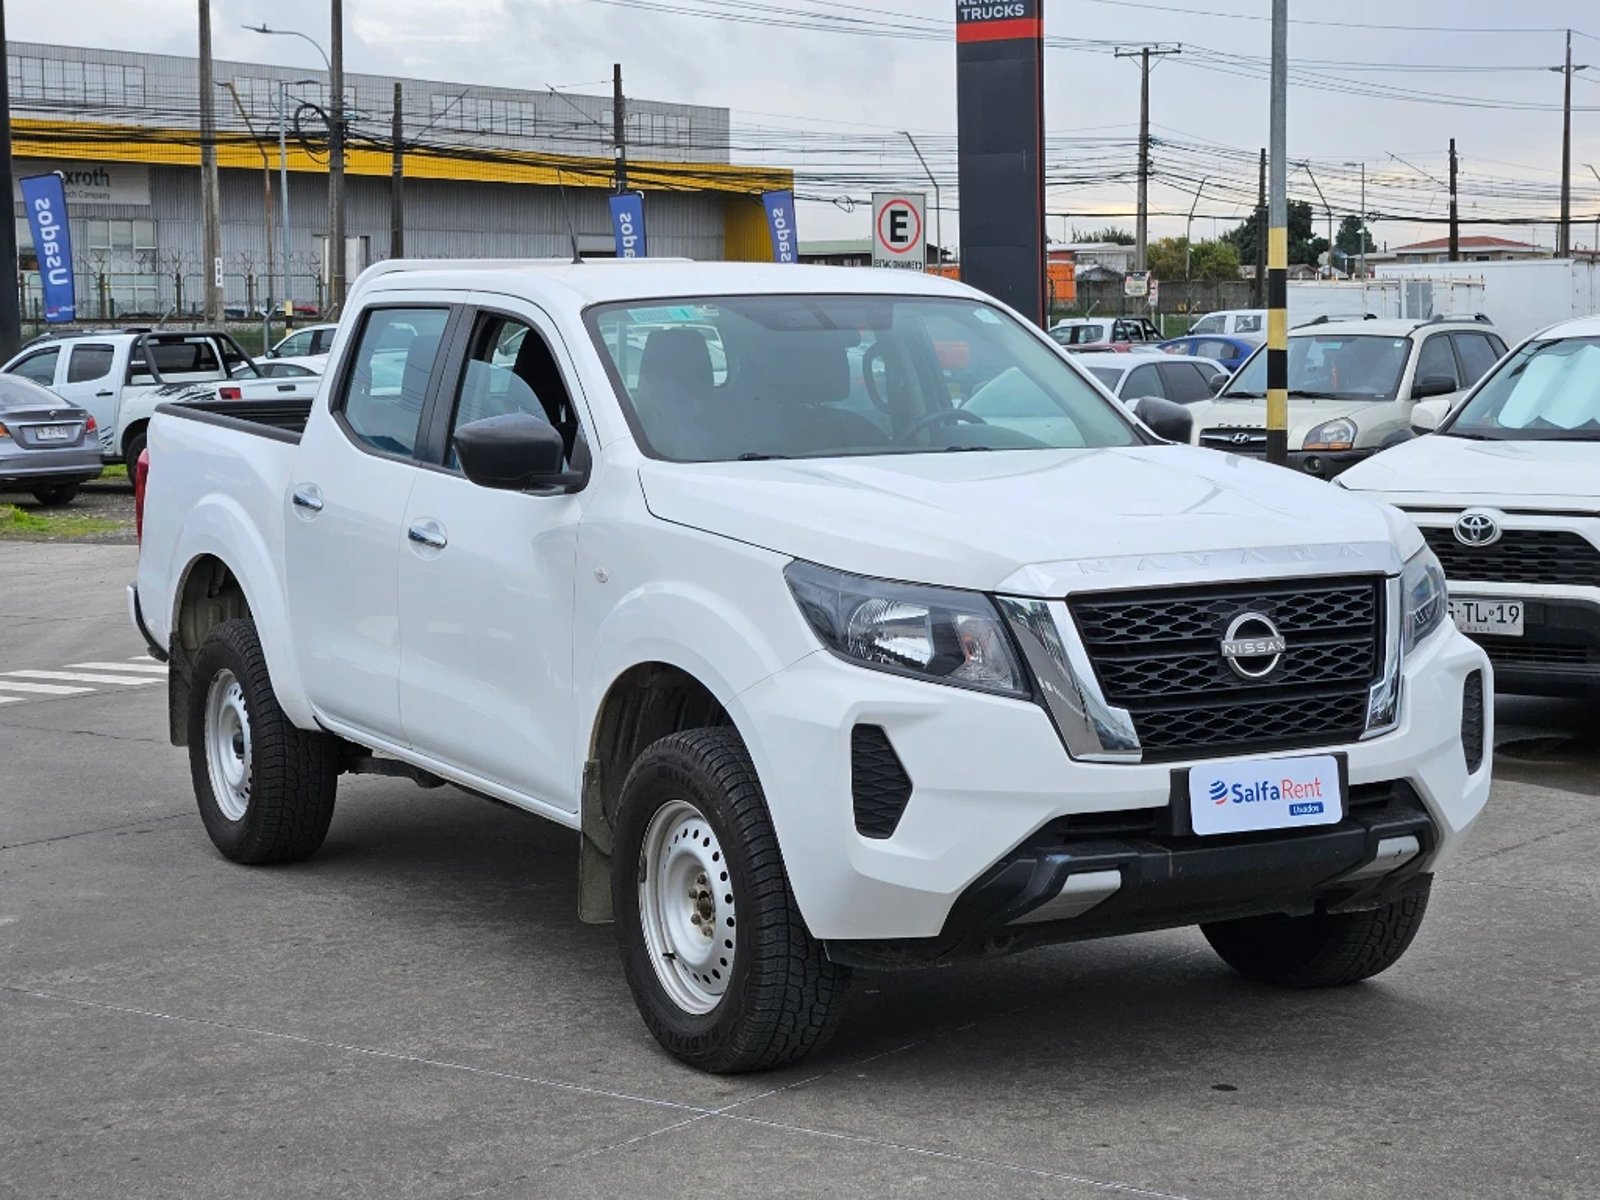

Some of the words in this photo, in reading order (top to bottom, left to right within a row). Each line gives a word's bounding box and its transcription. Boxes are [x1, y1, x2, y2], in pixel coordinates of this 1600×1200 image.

[961, 4, 1025, 20] TRUCKS
[64, 166, 111, 187] xroth
[890, 210, 908, 243] E
[1077, 543, 1363, 575] NAVARA
[1224, 640, 1286, 655] NISSAN
[1231, 777, 1322, 804] SalfaRent
